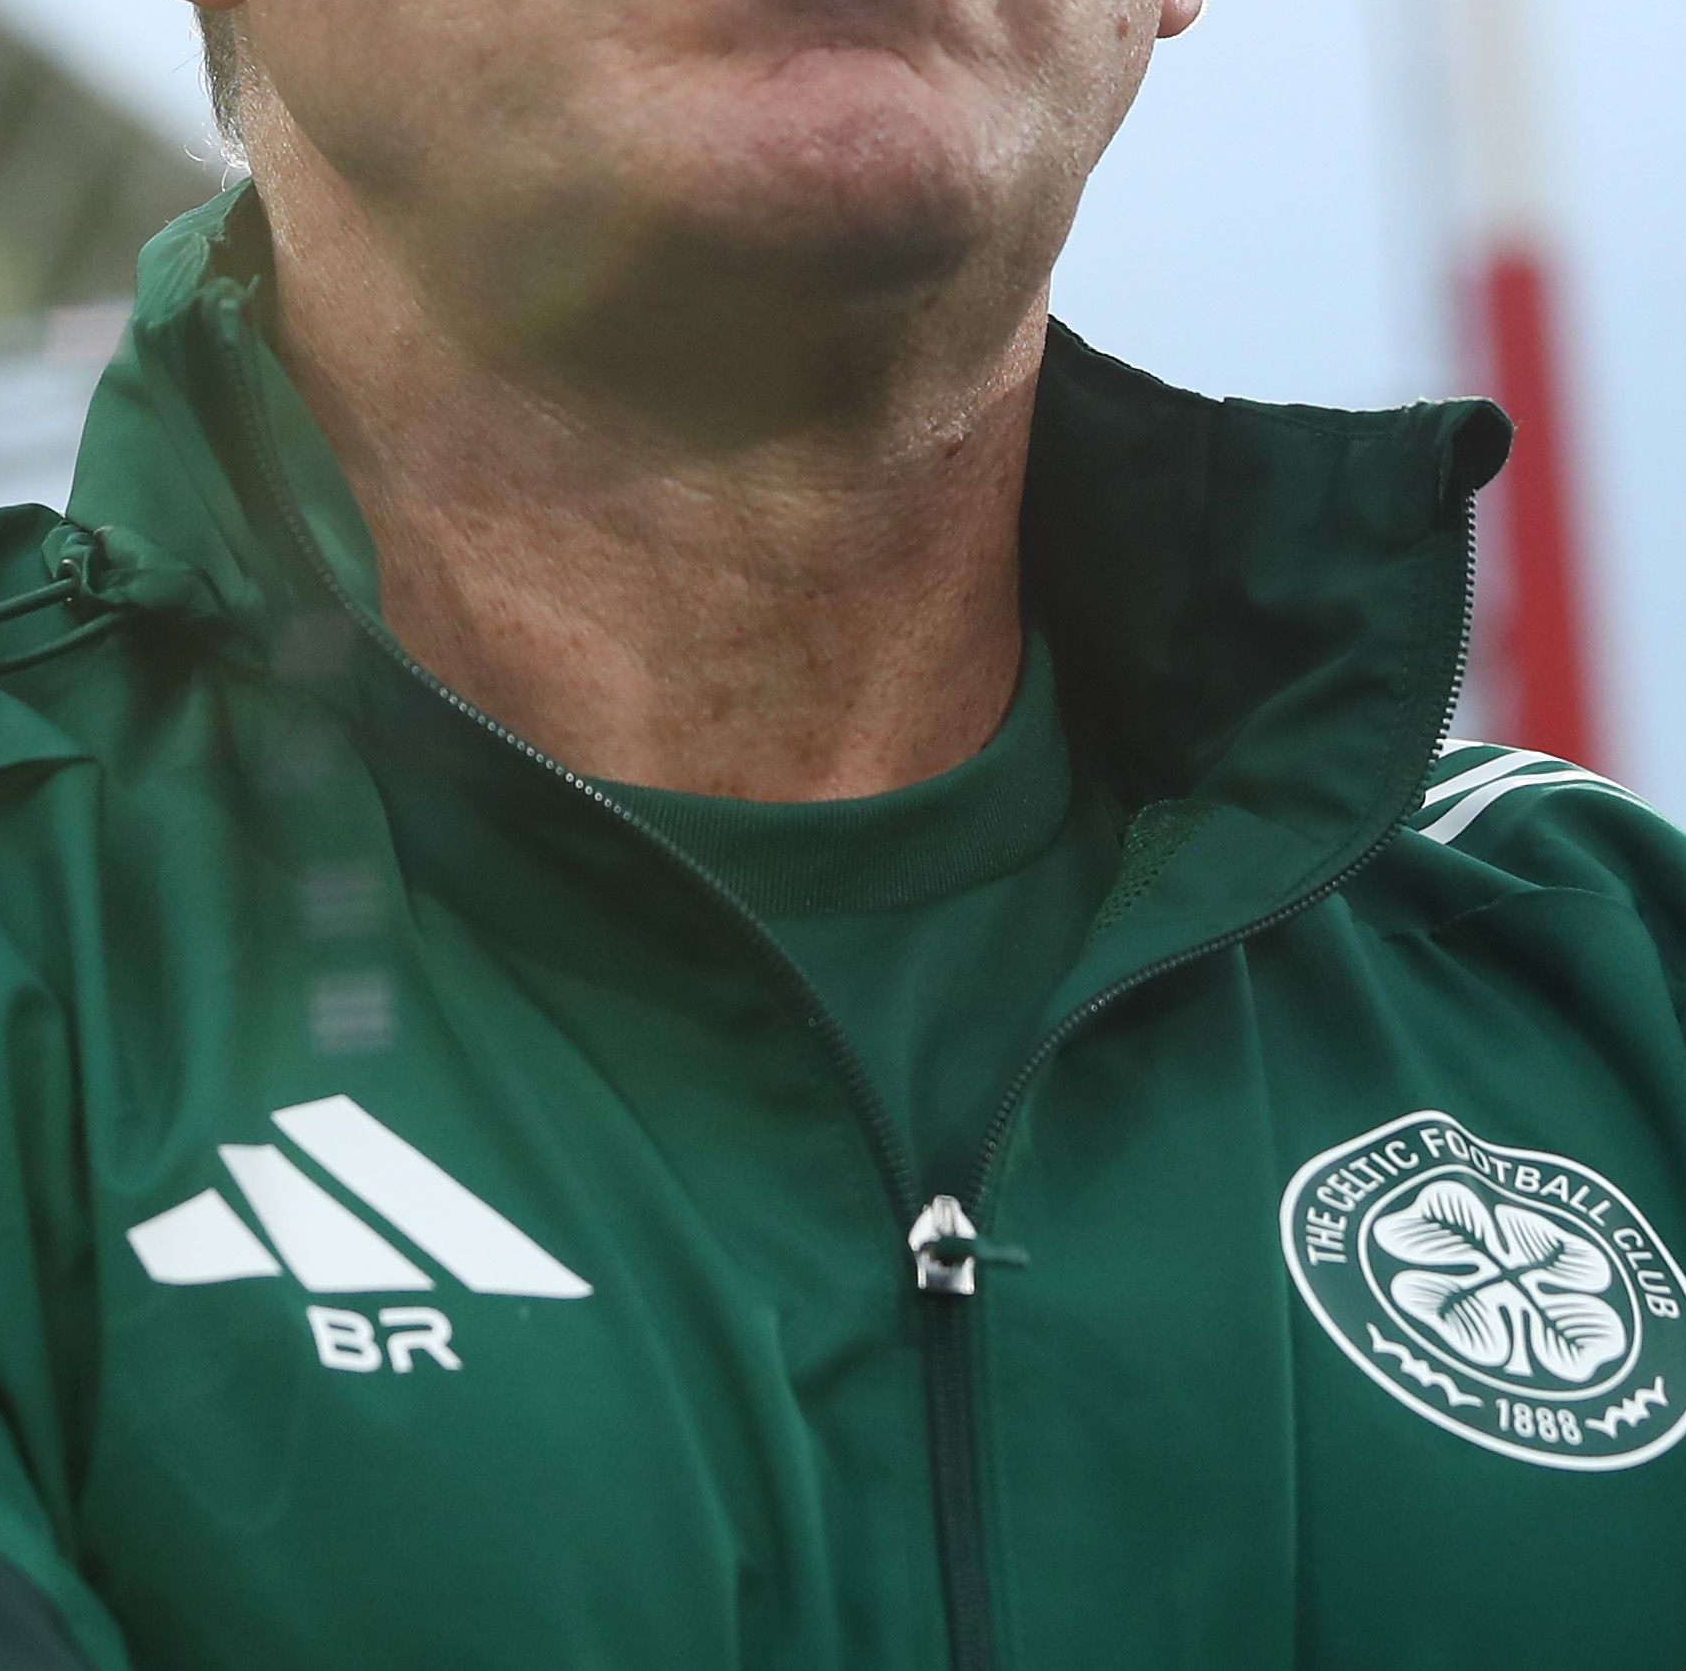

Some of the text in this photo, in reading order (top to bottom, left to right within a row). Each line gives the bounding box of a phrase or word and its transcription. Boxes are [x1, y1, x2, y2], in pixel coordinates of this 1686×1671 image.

[1305, 1127, 1680, 1319] THE CELTIC FOOTBALL CLUB
[305, 1304, 464, 1374] BR
[1495, 1397, 1583, 1446] 1888
